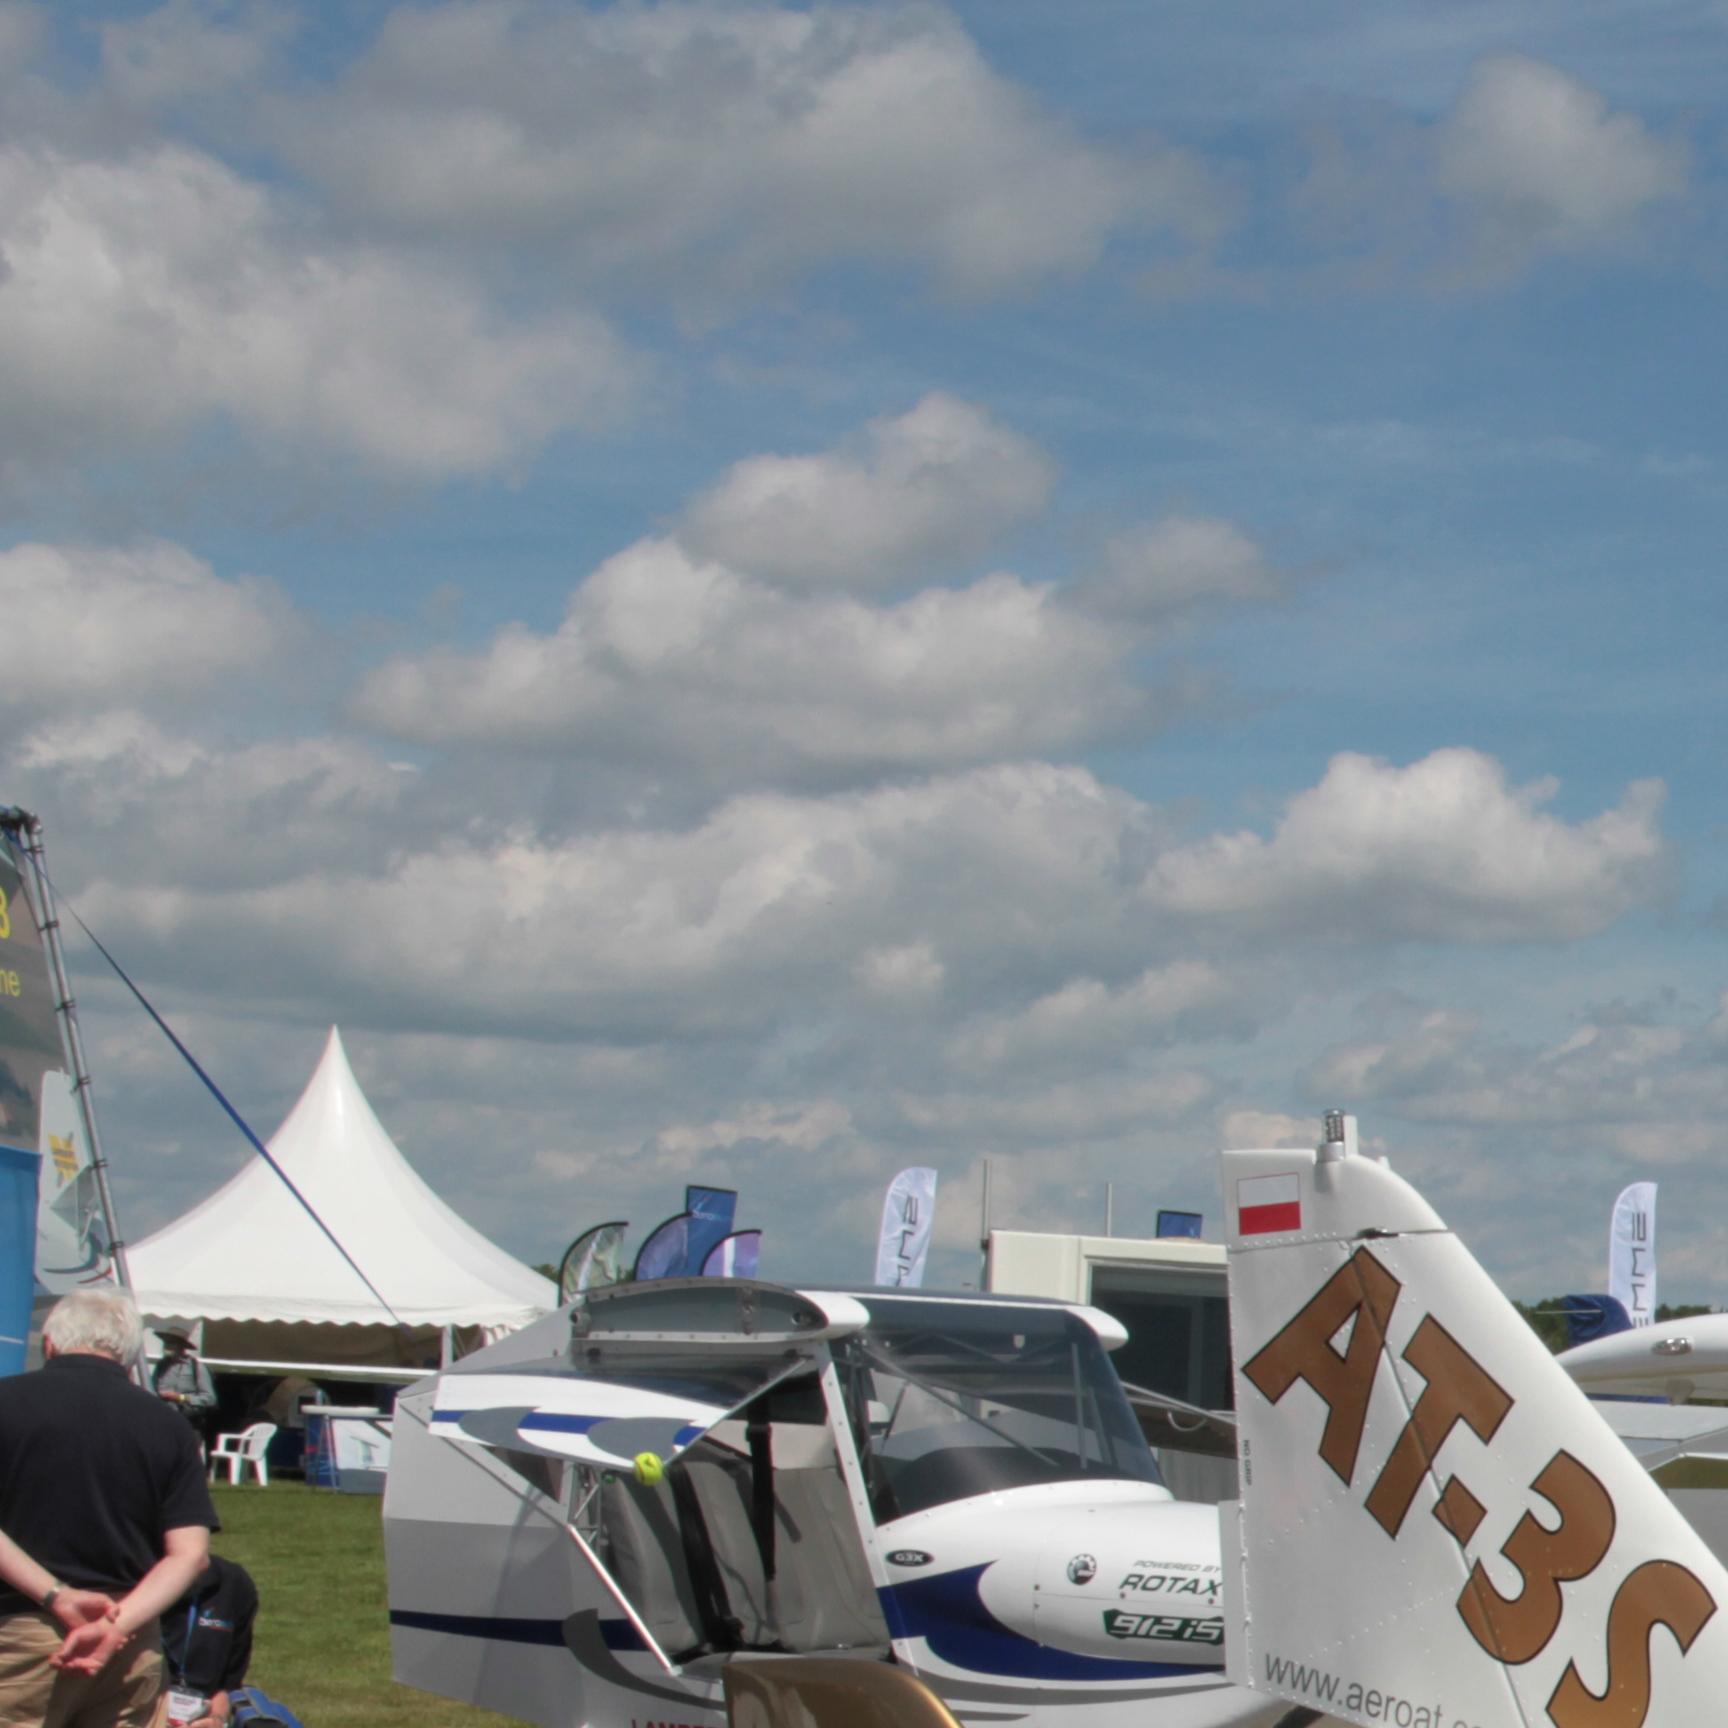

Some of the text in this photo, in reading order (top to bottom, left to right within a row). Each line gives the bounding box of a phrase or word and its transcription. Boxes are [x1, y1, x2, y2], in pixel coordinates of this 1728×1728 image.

[1133, 1560, 1202, 1572] POWERED
[1118, 1573, 1223, 1596] ROTAX
[1110, 1615, 1183, 1638] 912
